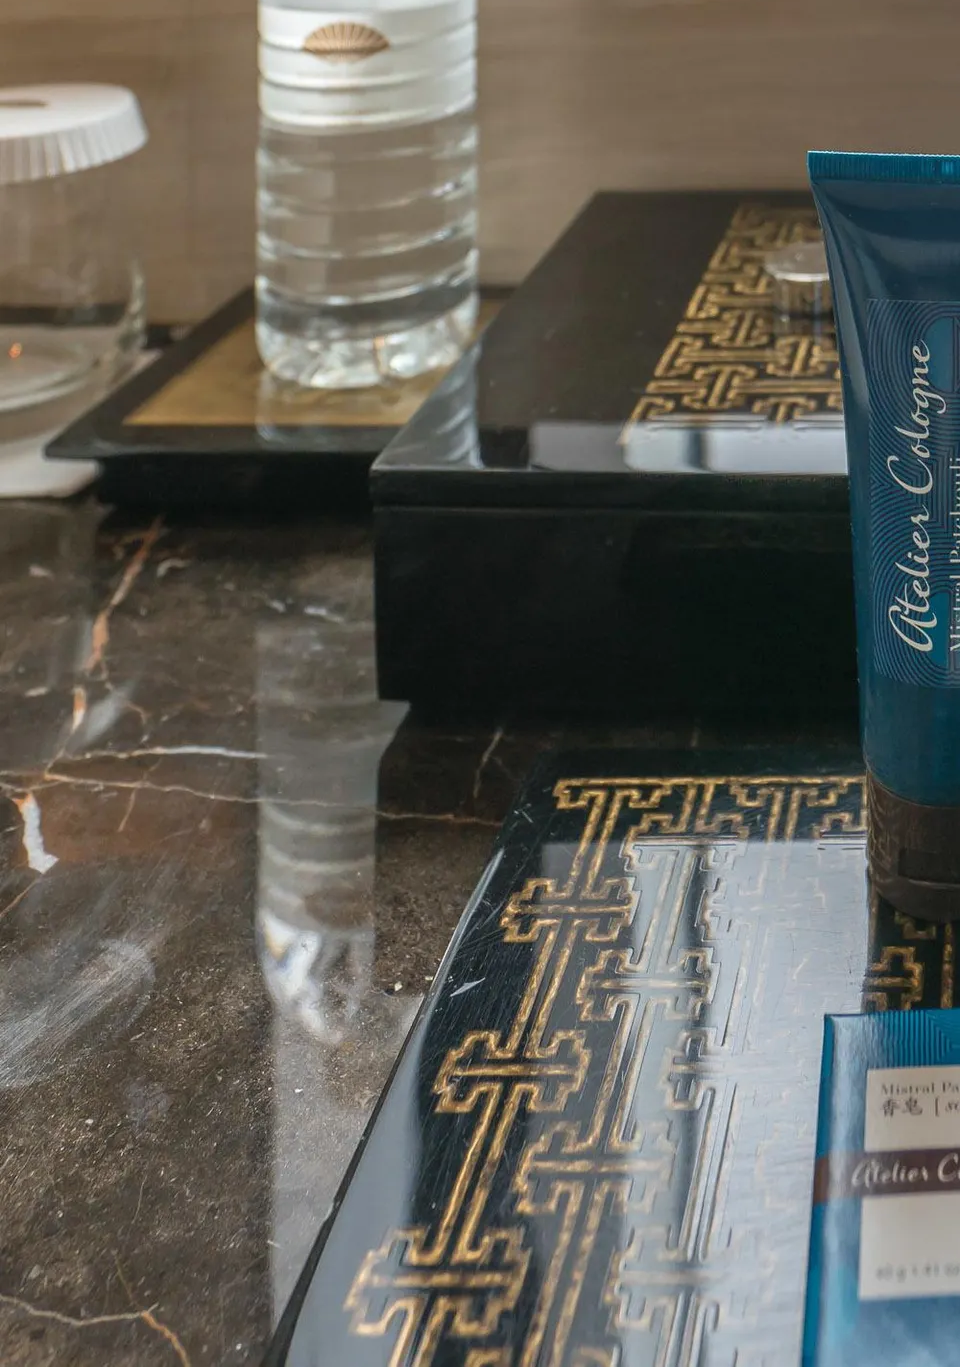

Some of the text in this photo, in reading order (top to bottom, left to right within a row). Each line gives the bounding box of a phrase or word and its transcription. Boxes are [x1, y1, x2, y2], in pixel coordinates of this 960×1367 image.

[886, 338, 947, 652] Atelier Cologne
[880, 1082, 935, 1096] Mistral
[881, 1096, 923, 1118] 香皂
[851, 1158, 930, 1189] Atelier
